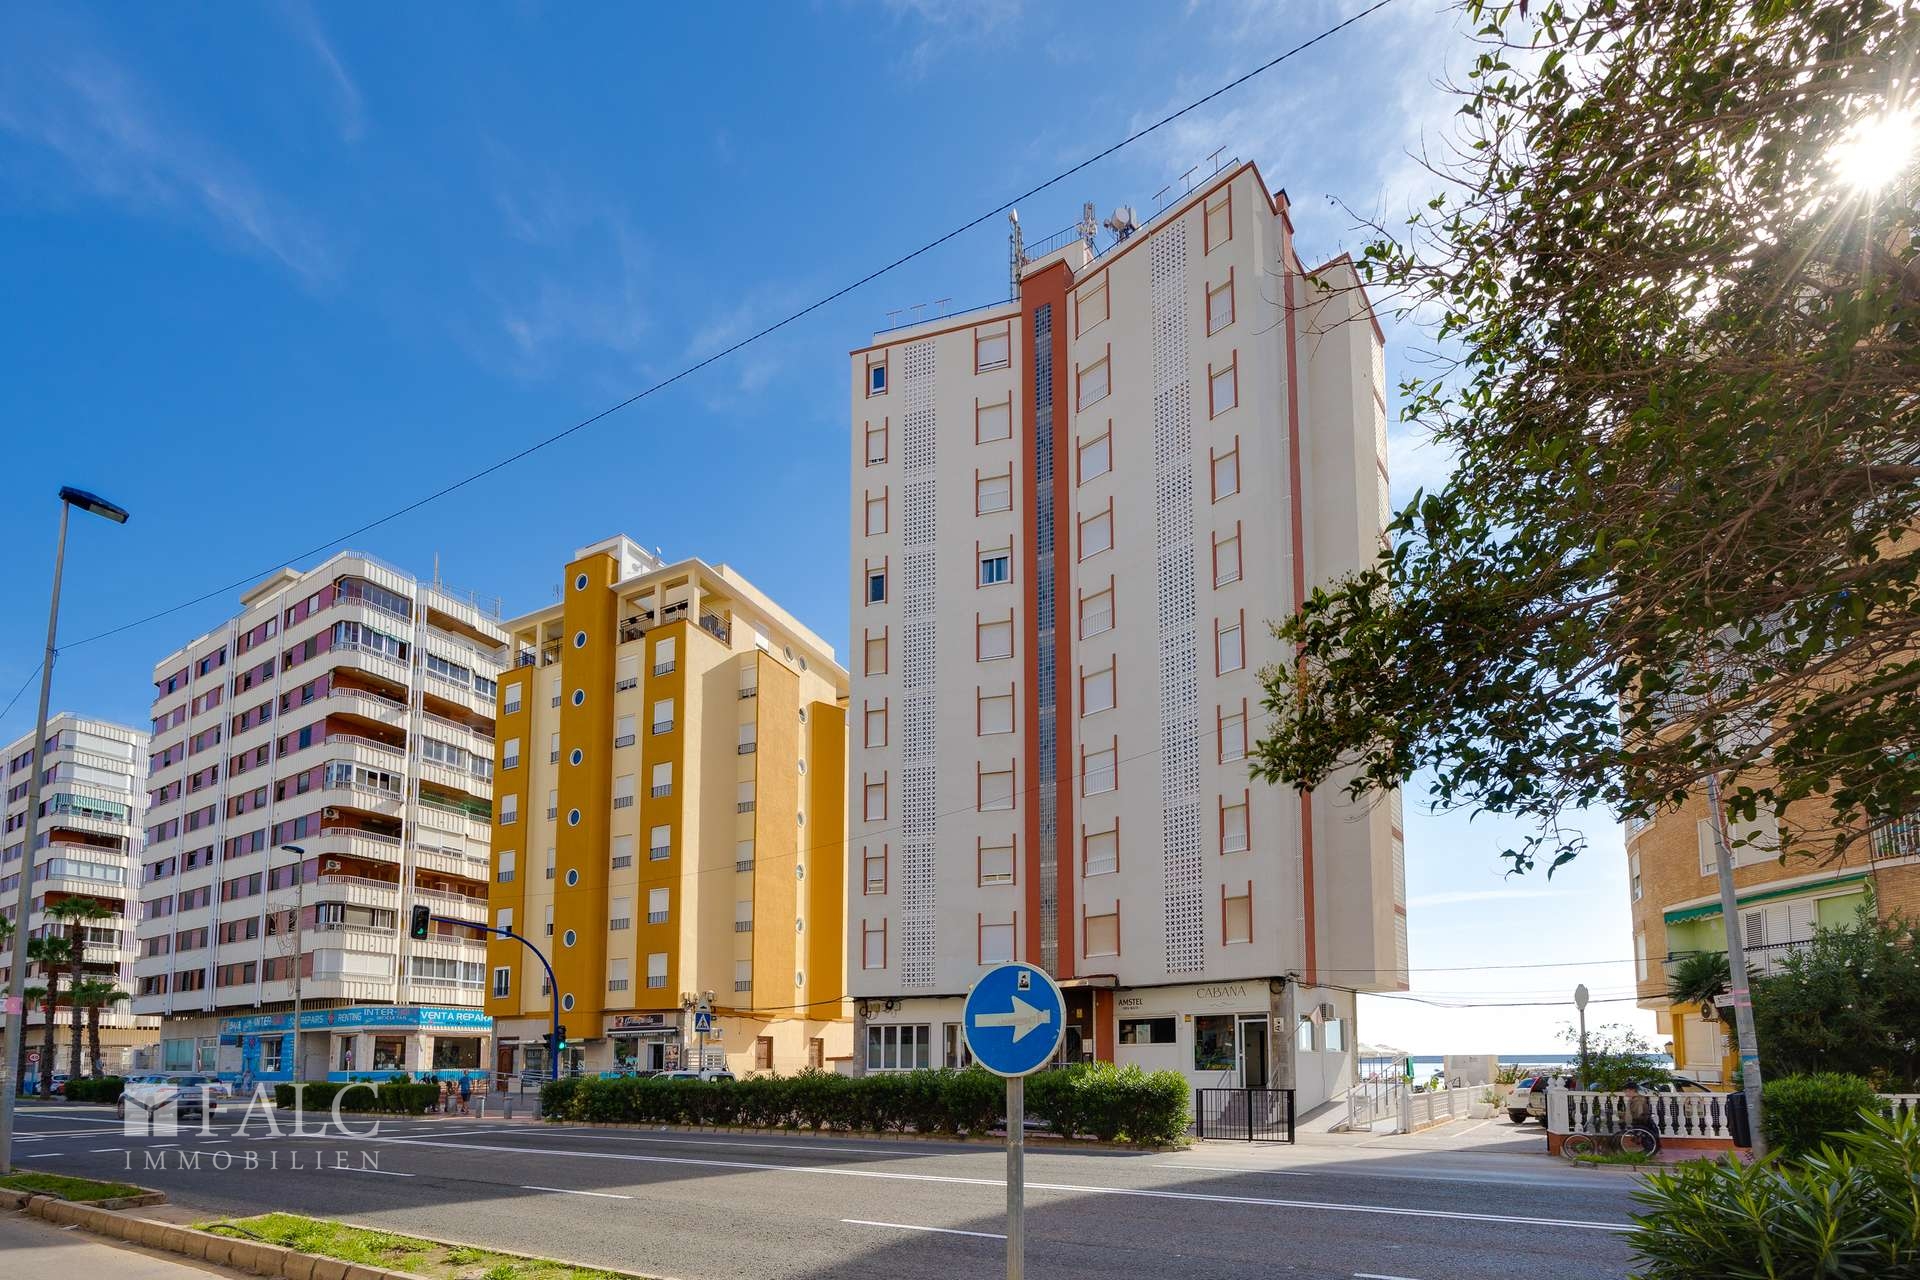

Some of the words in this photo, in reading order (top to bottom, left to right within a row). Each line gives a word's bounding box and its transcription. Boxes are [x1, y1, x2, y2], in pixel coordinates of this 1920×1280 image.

[1118, 998, 1143, 1006] AMSTEL
[337, 1013, 362, 1023] RENTING
[421, 1011, 454, 1021] VENTA
